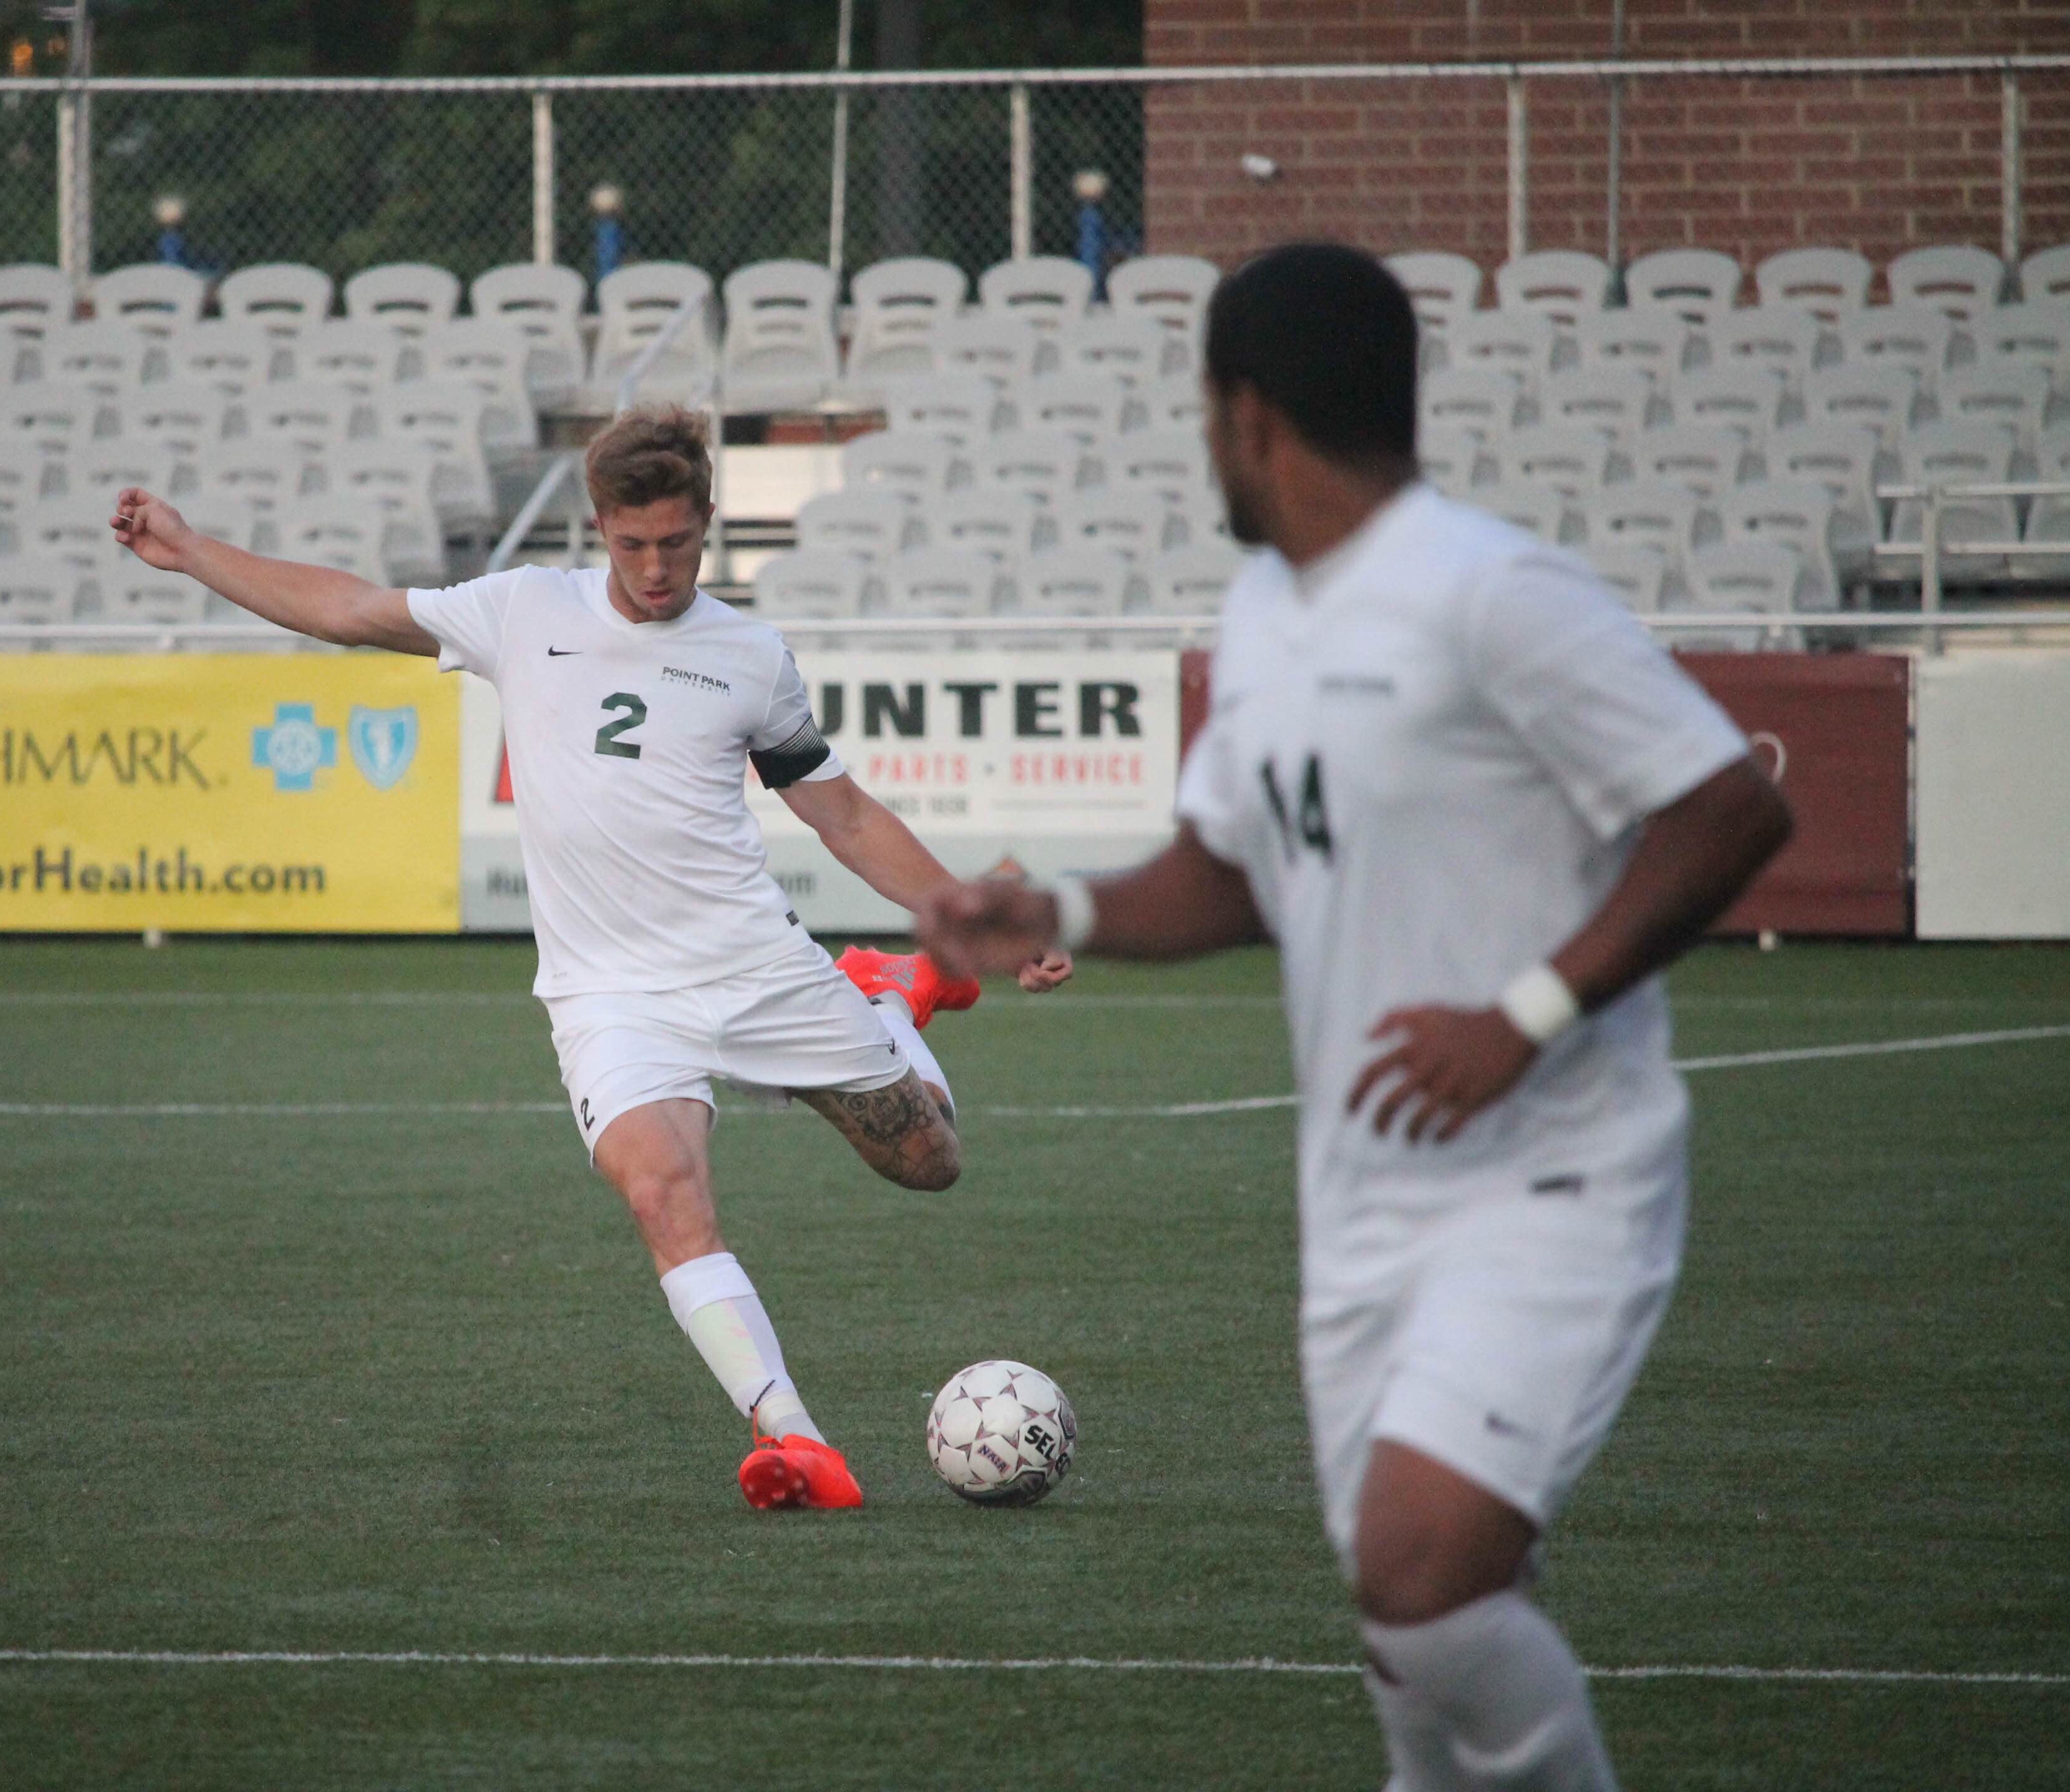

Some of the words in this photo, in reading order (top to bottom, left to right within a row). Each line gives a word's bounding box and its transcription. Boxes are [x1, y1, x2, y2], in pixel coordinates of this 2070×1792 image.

[663, 666, 699, 681] POINT
[702, 676, 730, 692] PARK
[595, 692, 647, 759] 2
[868, 754, 968, 783] PARTS
[1010, 753, 1143, 784] SERVICE
[1258, 752, 1335, 866] 14
[0, 845, 325, 892] rHealth.com
[581, 1097, 596, 1131] 2
